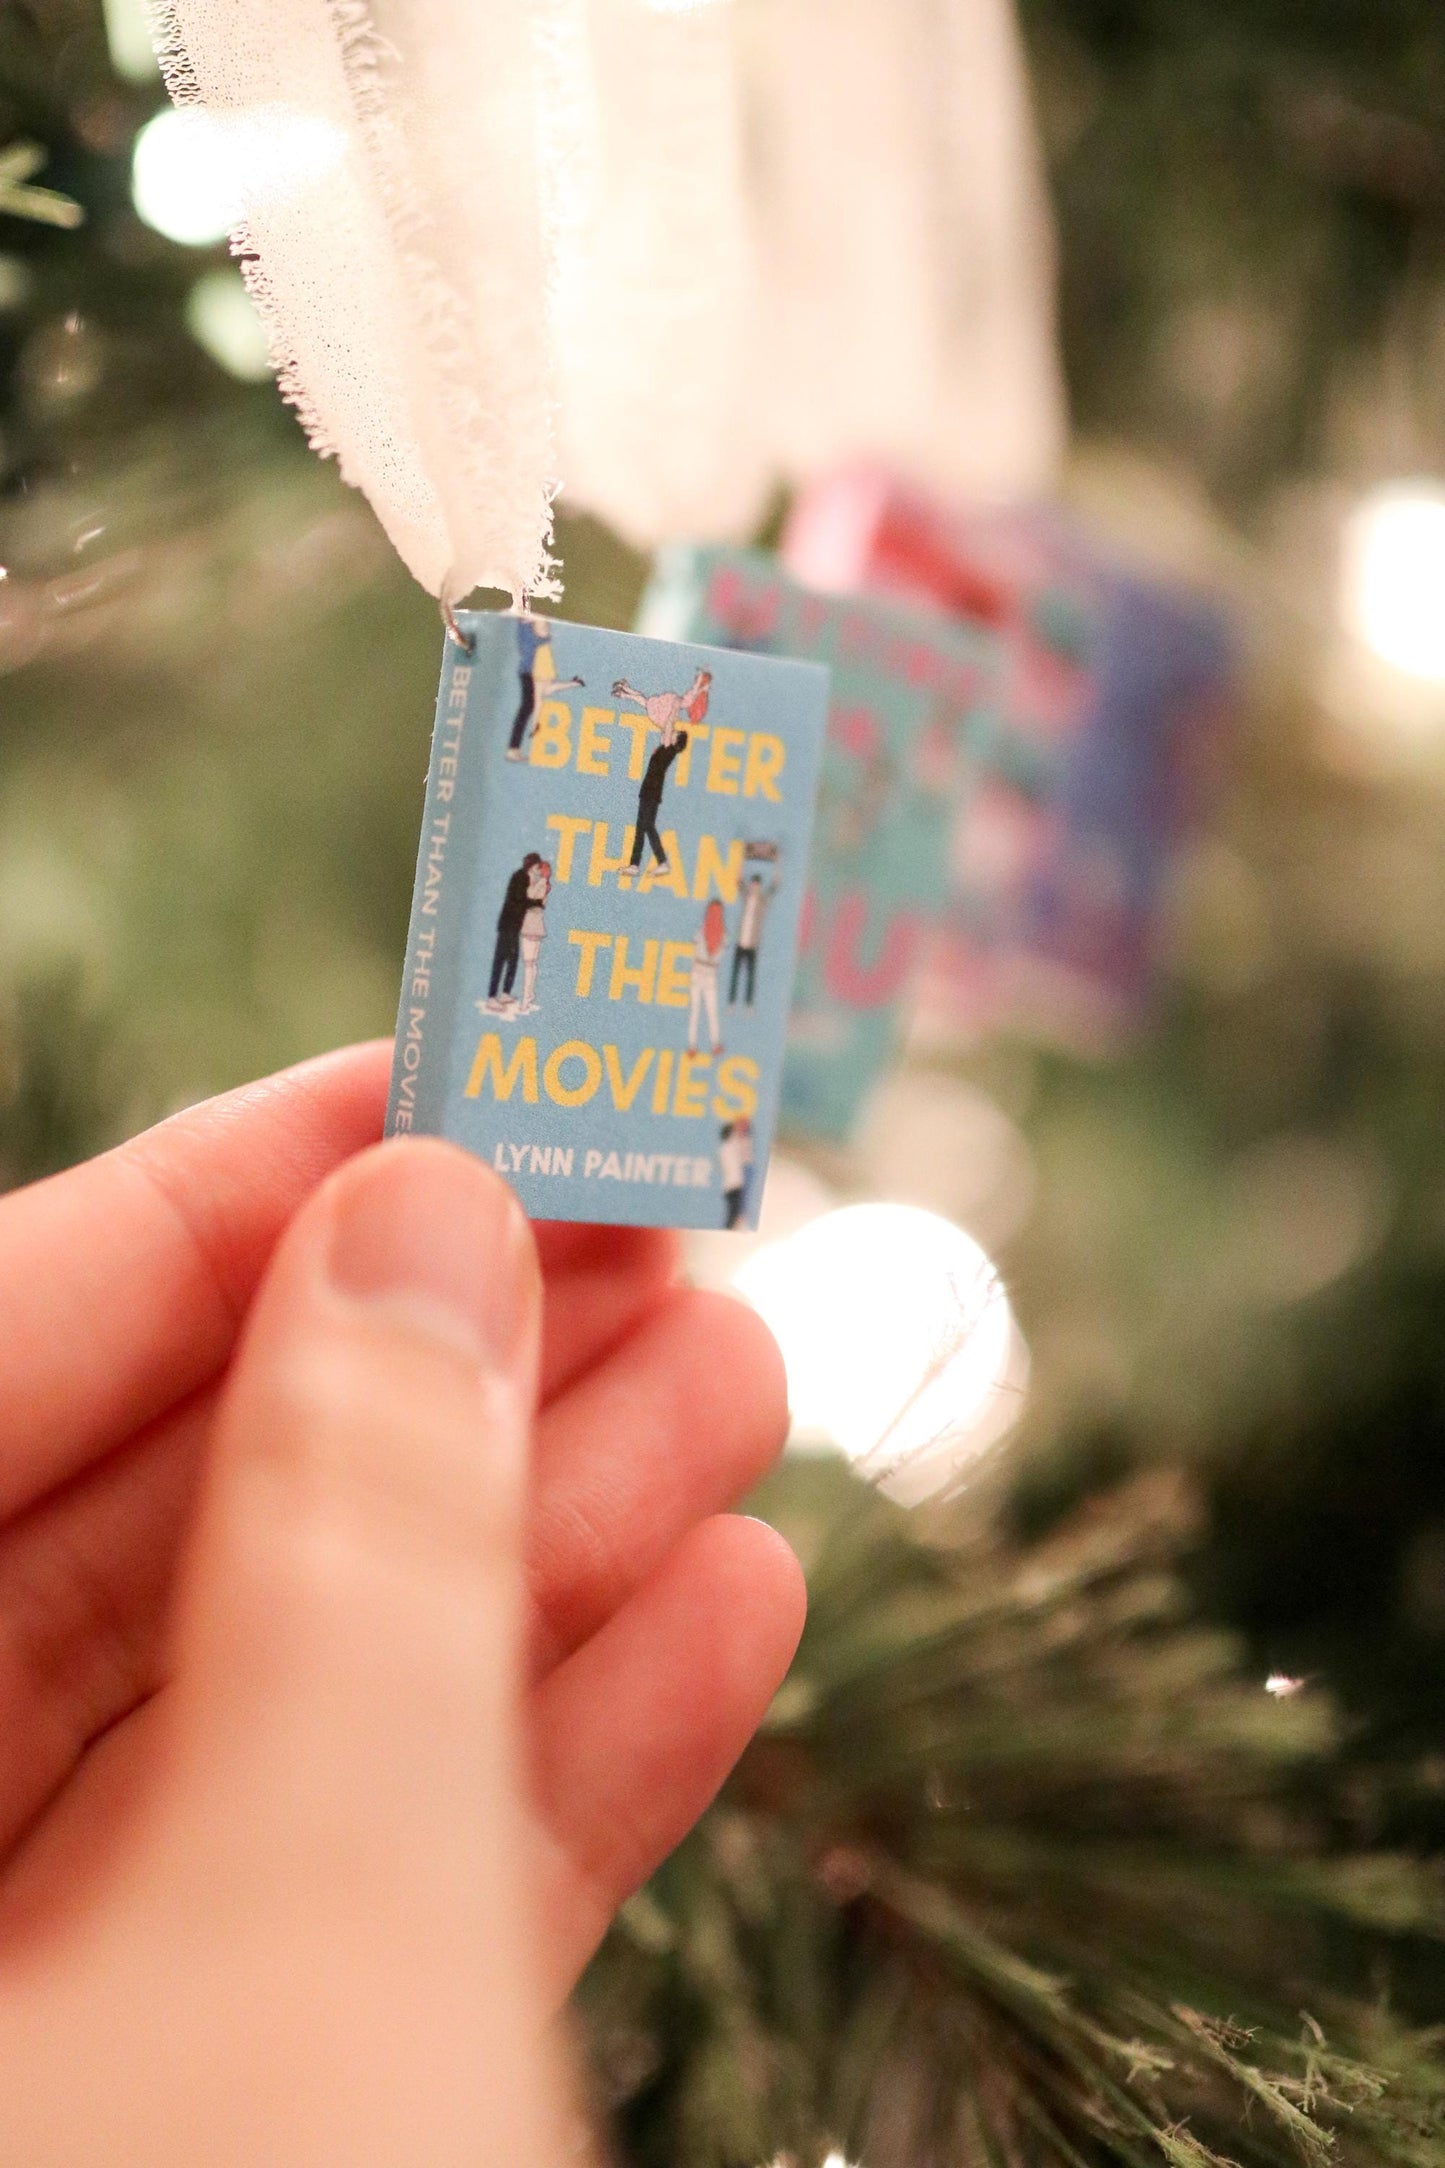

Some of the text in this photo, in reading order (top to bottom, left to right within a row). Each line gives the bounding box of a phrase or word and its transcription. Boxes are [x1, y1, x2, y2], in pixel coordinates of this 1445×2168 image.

[528, 699, 786, 802] BETTER
[394, 665, 472, 1138] BETTER THAN THE MOVIE
[546, 813, 744, 905] THAN
[567, 929, 696, 1007] THE
[463, 1032, 760, 1121] MOVIES
[494, 1142, 713, 1188] LYNN PAINTER
